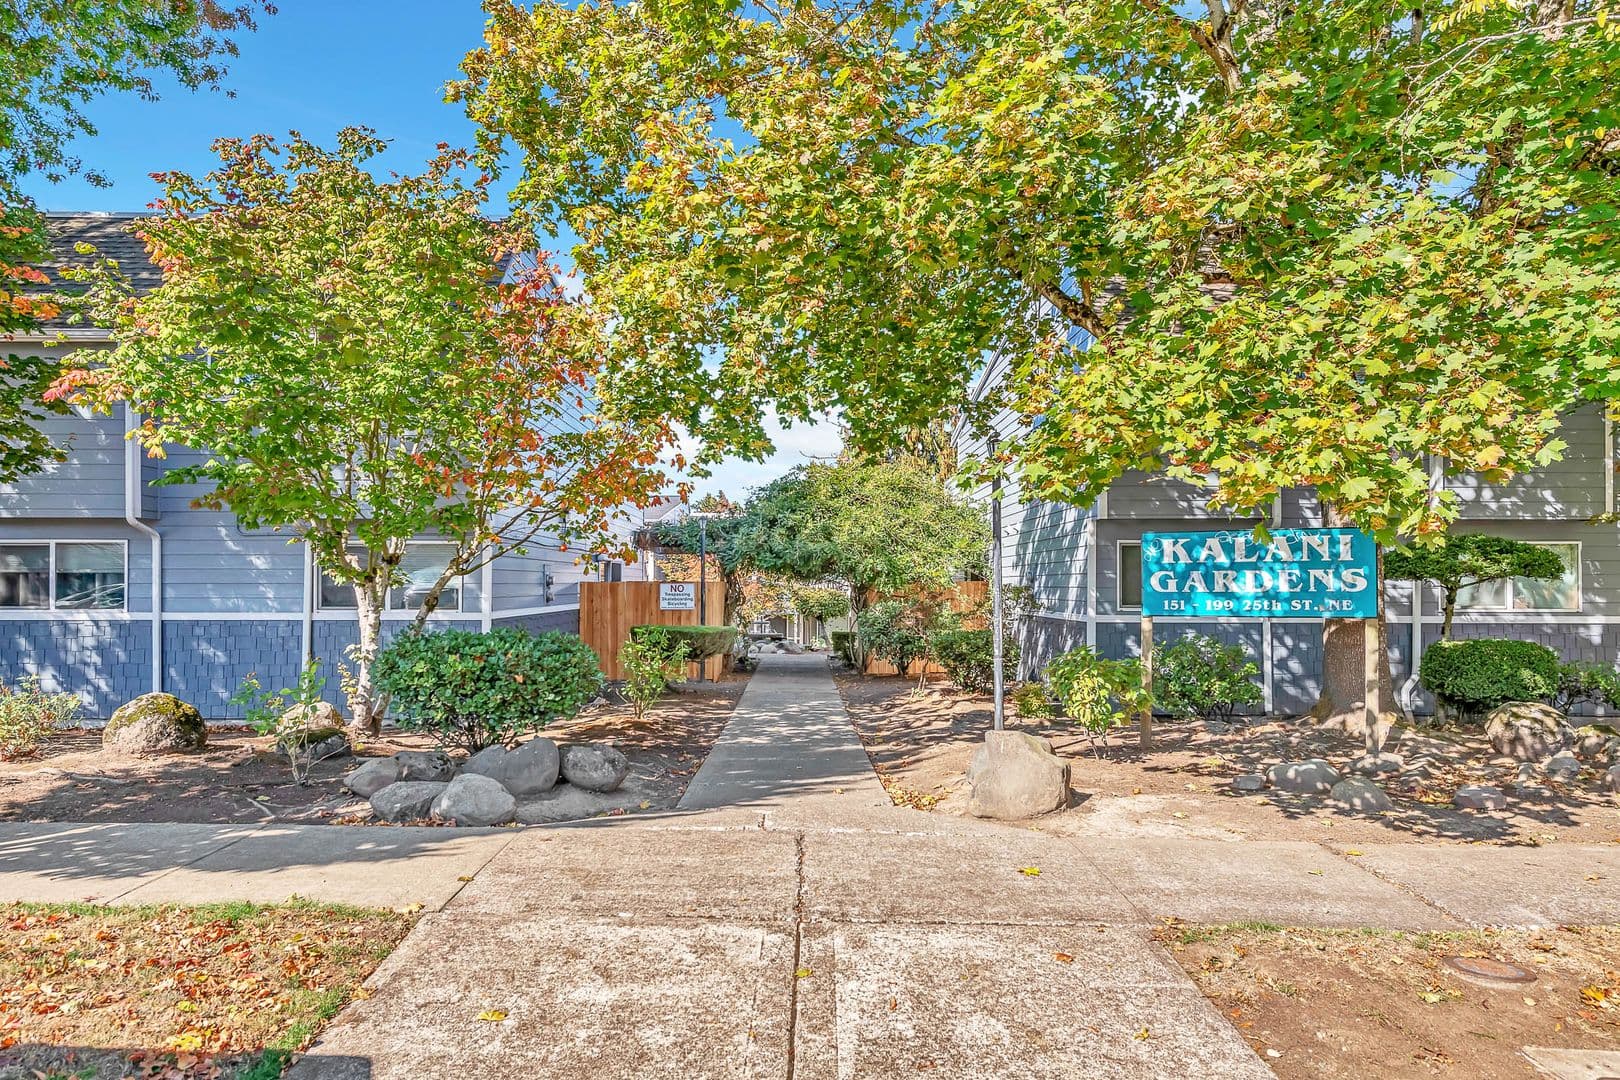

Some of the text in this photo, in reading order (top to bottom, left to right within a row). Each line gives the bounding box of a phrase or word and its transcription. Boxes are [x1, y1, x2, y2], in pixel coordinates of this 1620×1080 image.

[1160, 533, 1355, 564] KALANI
[670, 584, 685, 593] NO
[1150, 567, 1369, 594] GARDENS
[1163, 599, 1185, 610] 151
[1205, 599, 1234, 610] 199
[1243, 599, 1283, 611] 25th
[1327, 599, 1353, 611] NE
